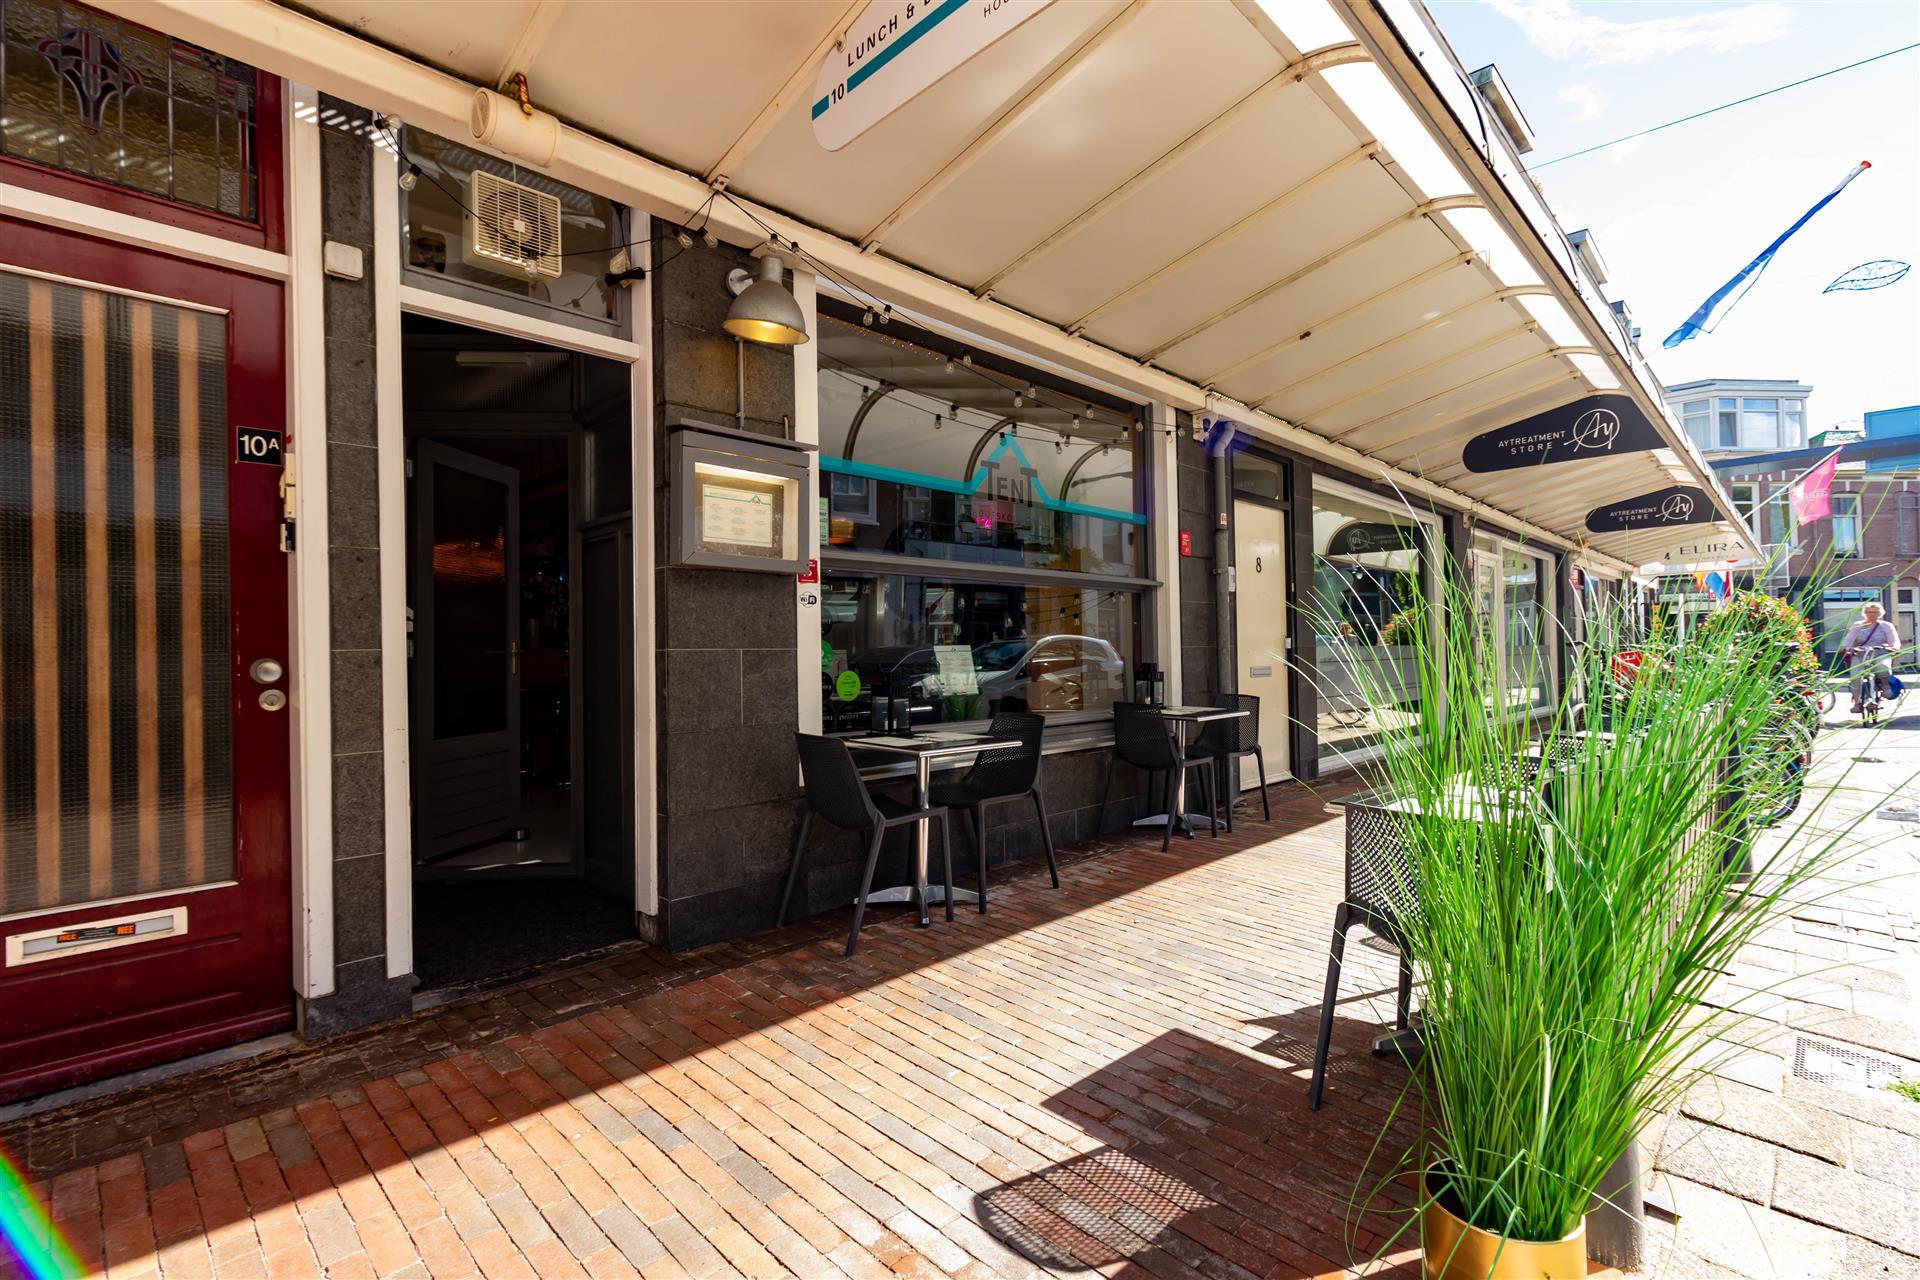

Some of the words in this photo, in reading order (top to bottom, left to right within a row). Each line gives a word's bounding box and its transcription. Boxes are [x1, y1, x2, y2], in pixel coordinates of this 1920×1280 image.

[847, 14, 897, 67] LUNCH
[906, 3, 914, 19] &
[832, 83, 844, 104] 10
[240, 435, 279, 456] 10A
[1498, 430, 1566, 448] AYTREATMENT
[1511, 442, 1552, 455] STORE
[981, 460, 1037, 507] TENT
[1609, 507, 1657, 517] AYTREATMENT
[1619, 514, 1648, 522] STORE
[1680, 541, 1744, 555] ELIRA
[1255, 556, 1262, 573] 8
[116, 925, 134, 935] NEE
